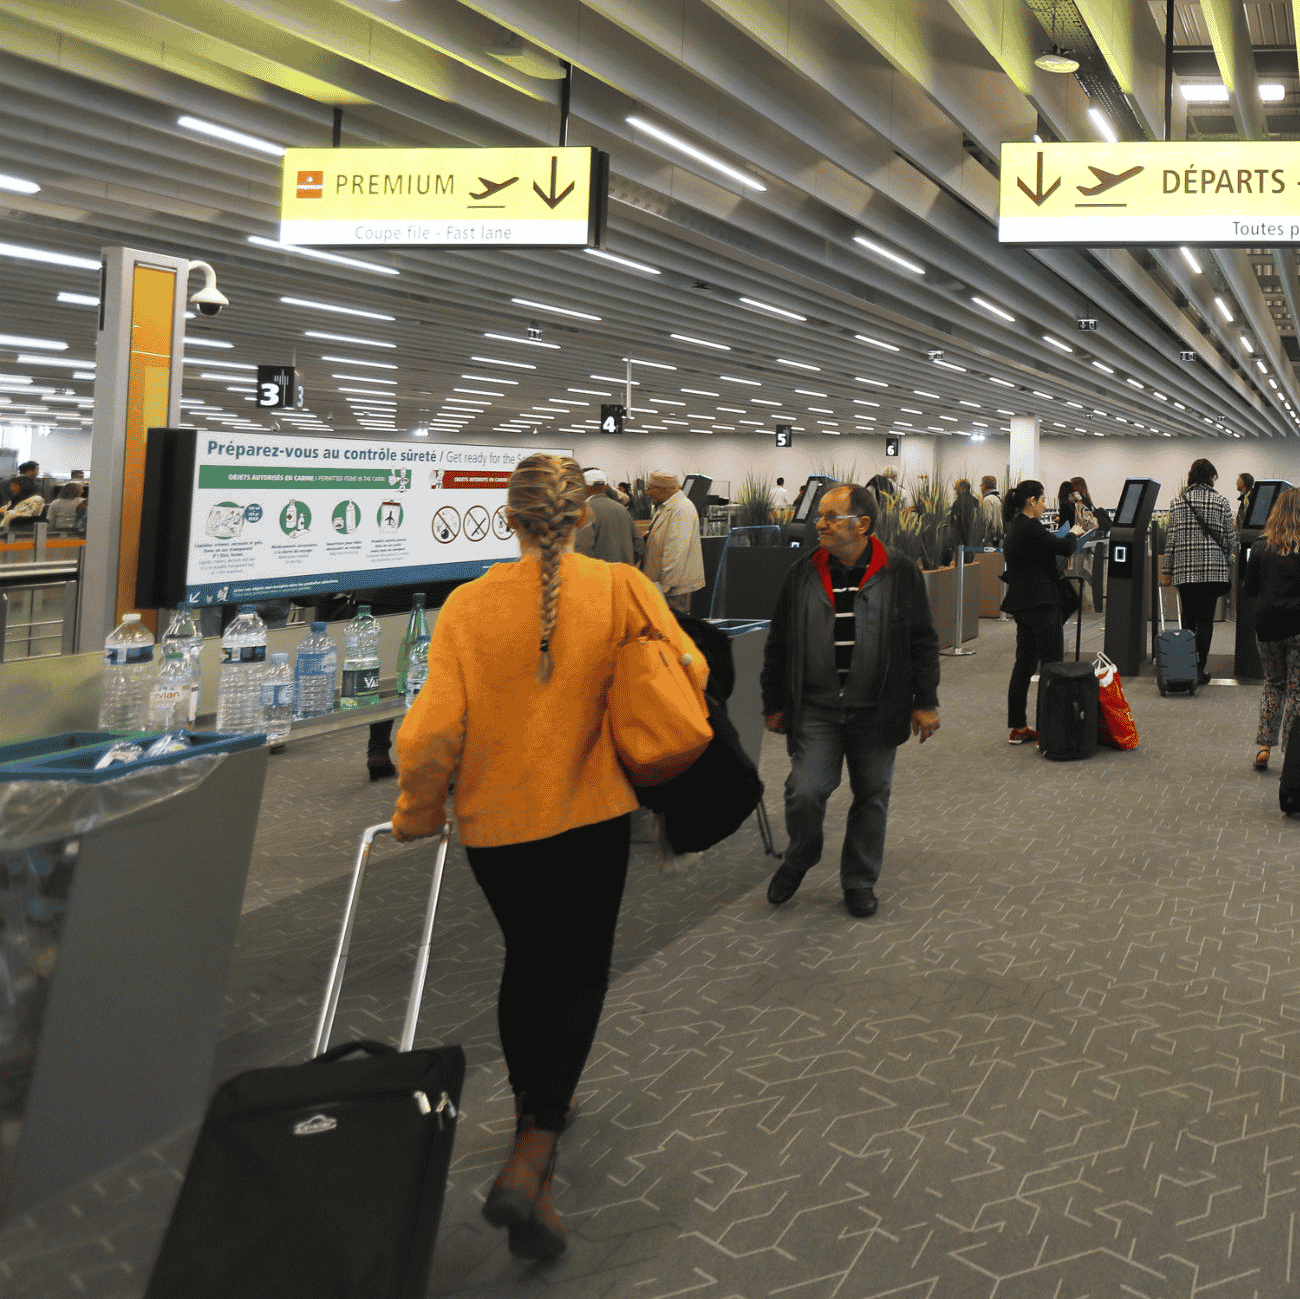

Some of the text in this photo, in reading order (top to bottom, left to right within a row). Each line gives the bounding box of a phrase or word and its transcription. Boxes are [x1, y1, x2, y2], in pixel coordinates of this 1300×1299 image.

[336, 174, 455, 195] PREMIUM
[1162, 164, 1286, 195] DÉPARTS
[354, 225, 401, 243] Coupe
[407, 224, 430, 240] file
[446, 225, 475, 240] Fast
[480, 224, 512, 240] lane
[1232, 221, 1285, 236] Toutes
[260, 382, 280, 407] 3
[602, 416, 616, 433] 4
[777, 433, 787, 447] 5
[207, 440, 319, 460] Préparez-vous
[323, 447, 340, 460] au
[344, 447, 397, 461] contrôle
[400, 448, 437, 463] sûreté
[446, 451, 463, 464] Get
[464, 452, 488, 467] ready
[489, 452, 502, 465] for
[503, 452, 516, 465] the
[887, 445, 895, 456] 6
